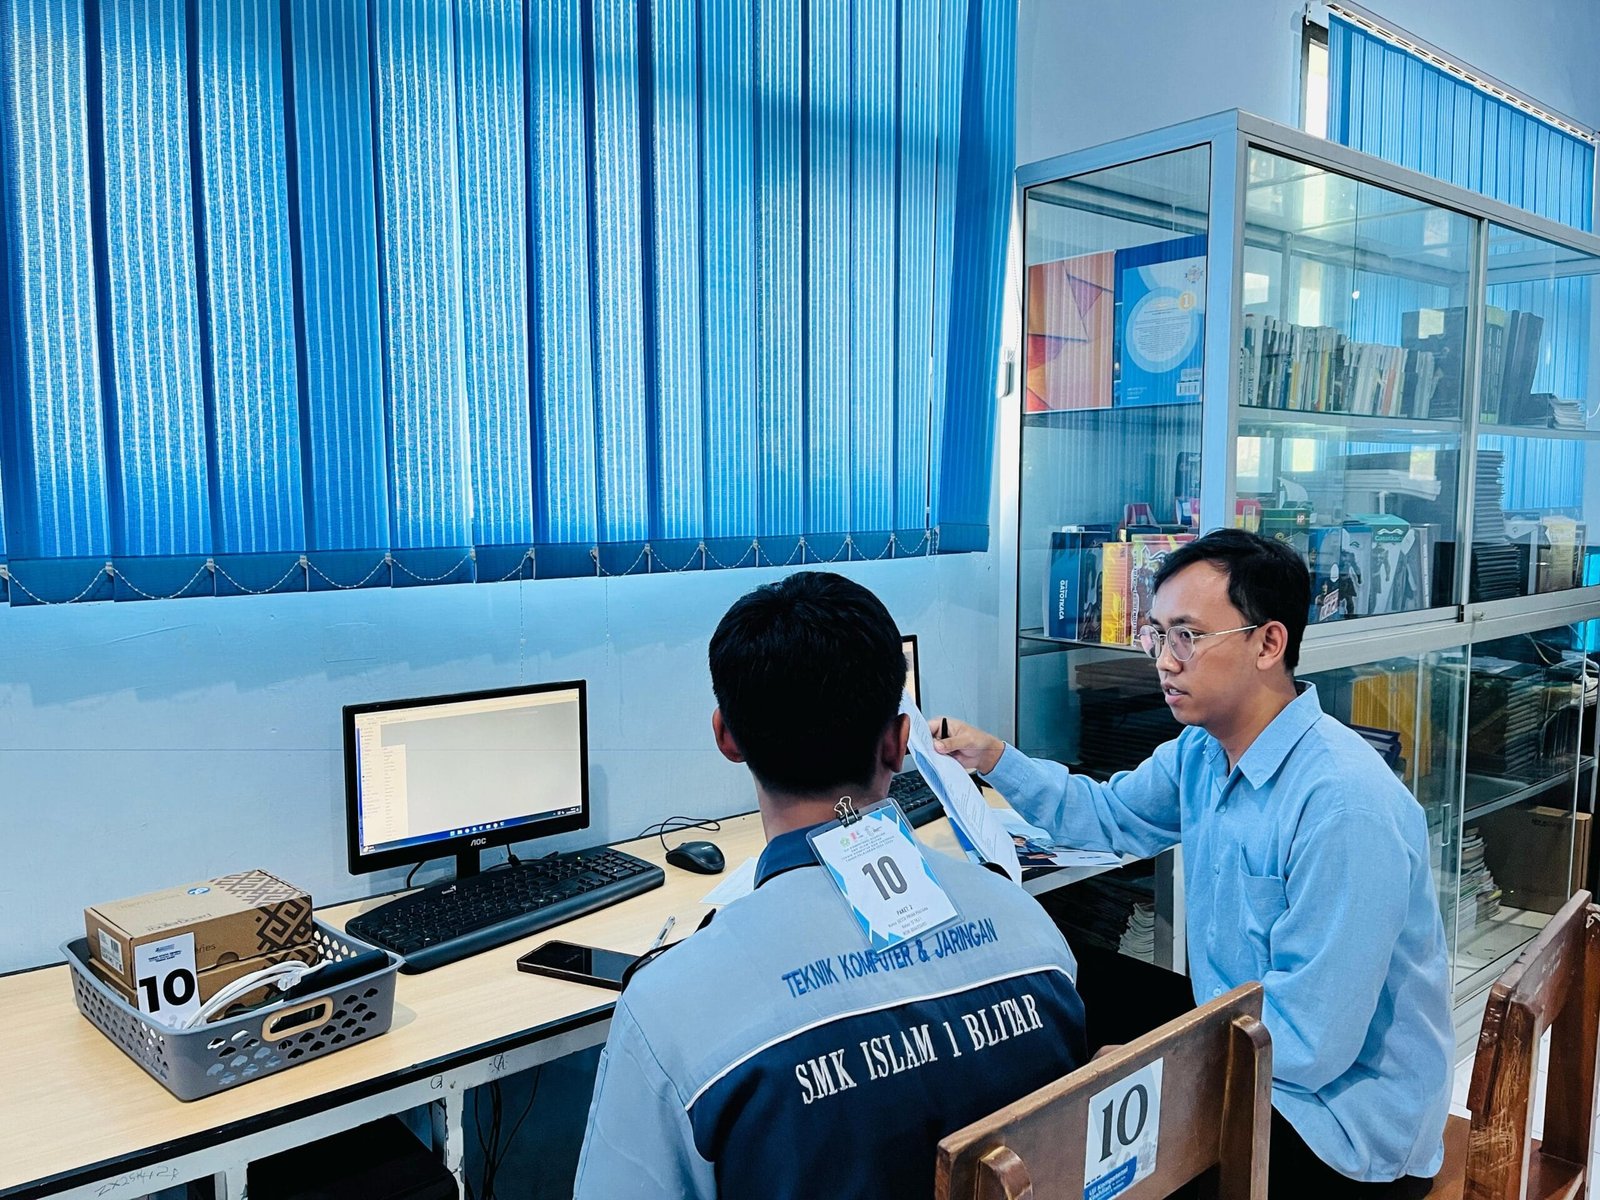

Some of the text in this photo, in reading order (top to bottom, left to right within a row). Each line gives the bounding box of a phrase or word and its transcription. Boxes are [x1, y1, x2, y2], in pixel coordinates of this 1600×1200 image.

[470, 837, 487, 847] AOC
[861, 855, 908, 901] 10
[781, 918, 999, 998] TEKNIK KOMPUTER & JARINGAN
[138, 968, 196, 1014] 10
[795, 993, 1044, 1105] SMK ISLAM 1 BLITAR
[1098, 1083, 1148, 1163] 10
